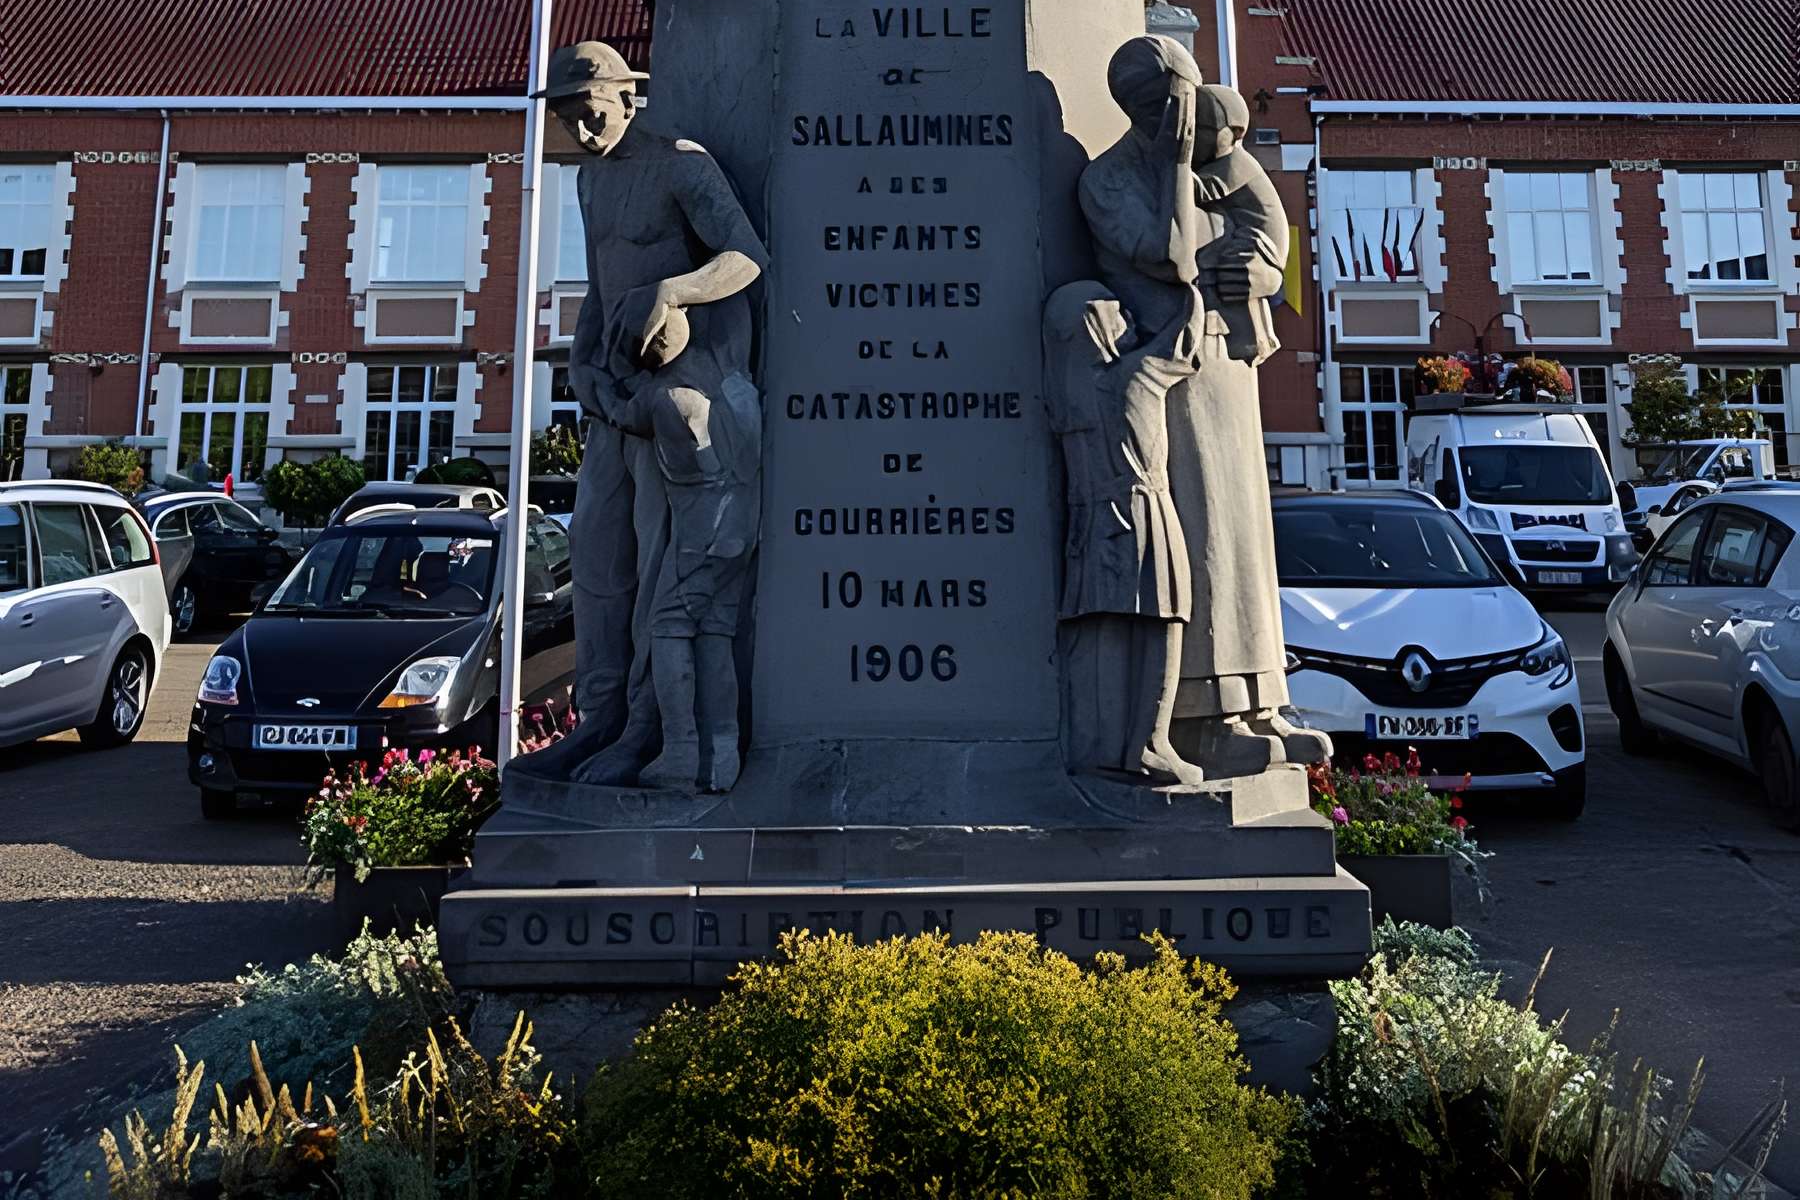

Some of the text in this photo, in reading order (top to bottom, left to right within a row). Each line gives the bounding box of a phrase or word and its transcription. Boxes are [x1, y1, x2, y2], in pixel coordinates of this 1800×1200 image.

[815, 7, 992, 38] LA VILLE
[882, 67, 926, 86] DE
[791, 114, 1013, 146] SALLAUMINES
[889, 176, 947, 194] DES
[824, 225, 981, 251] ENFANTS
[825, 282, 981, 308] VICTIMES
[858, 340, 949, 360] DE LA
[786, 391, 1022, 420] CATASTROPHE
[883, 453, 923, 473] DE
[821, 570, 988, 609] 10 MARS
[850, 643, 958, 682] 1906
[1034, 905, 1331, 943] PUBLIQUE
